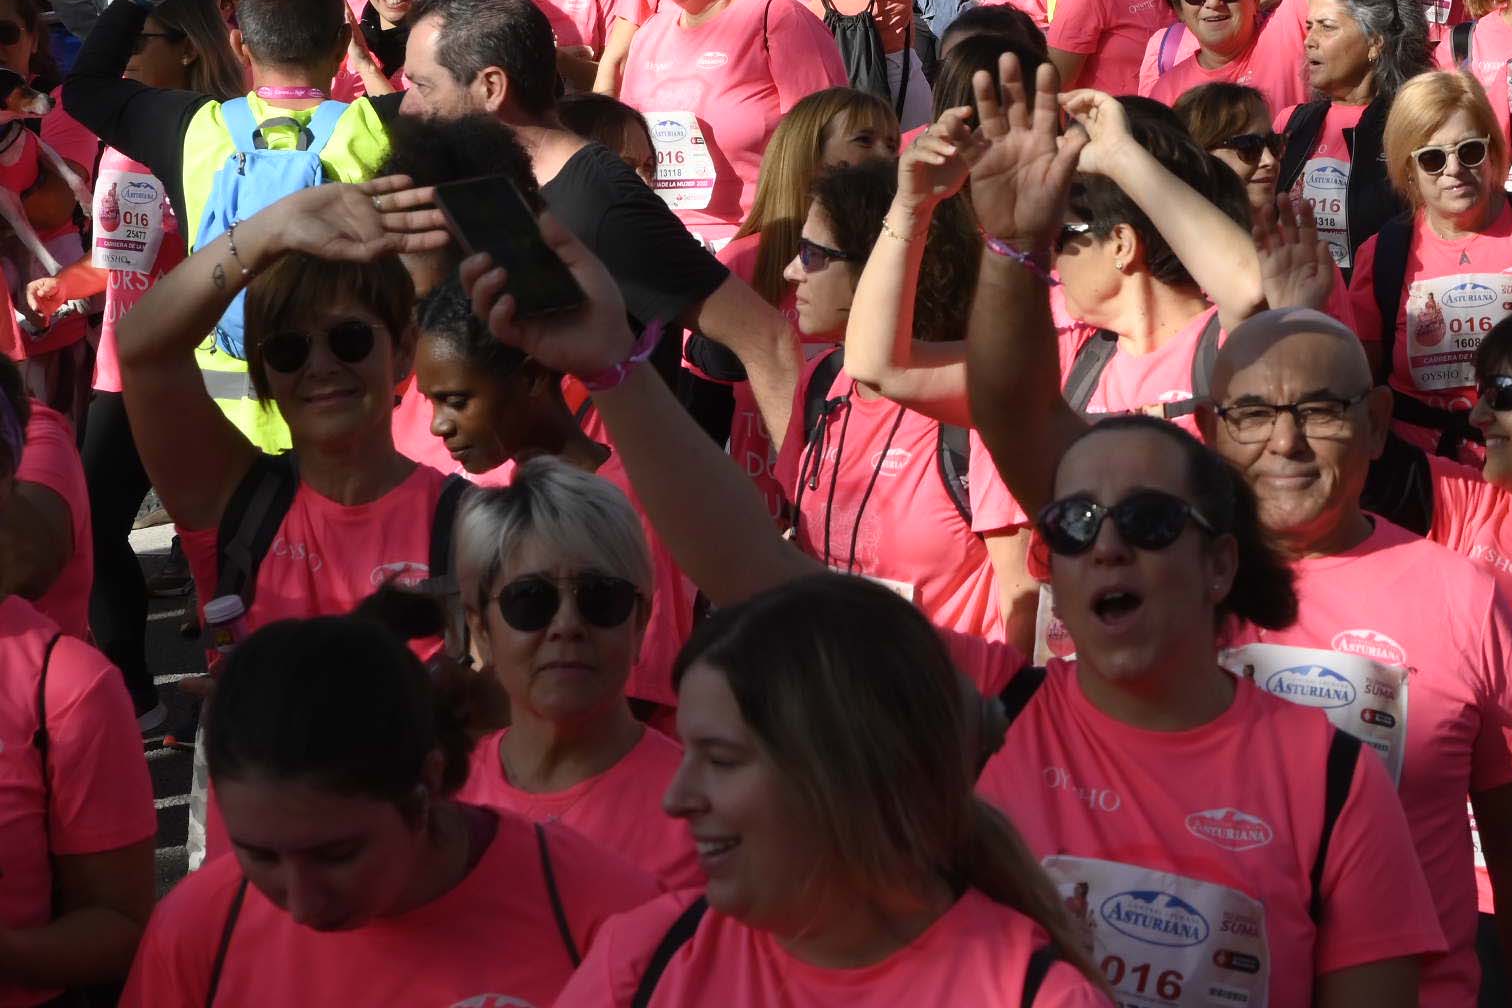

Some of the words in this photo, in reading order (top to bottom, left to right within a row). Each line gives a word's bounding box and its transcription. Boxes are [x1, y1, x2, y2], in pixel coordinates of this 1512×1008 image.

[657, 150, 684, 164] 016
[123, 211, 148, 227] 016
[1450, 317, 1493, 333] 016
[1274, 677, 1349, 702] ASTURIANA
[1365, 684, 1394, 700] SUMA
[1192, 822, 1265, 842] ASTURIANA
[1108, 902, 1199, 940] ASTURIANA
[1101, 955, 1184, 1001] 016
